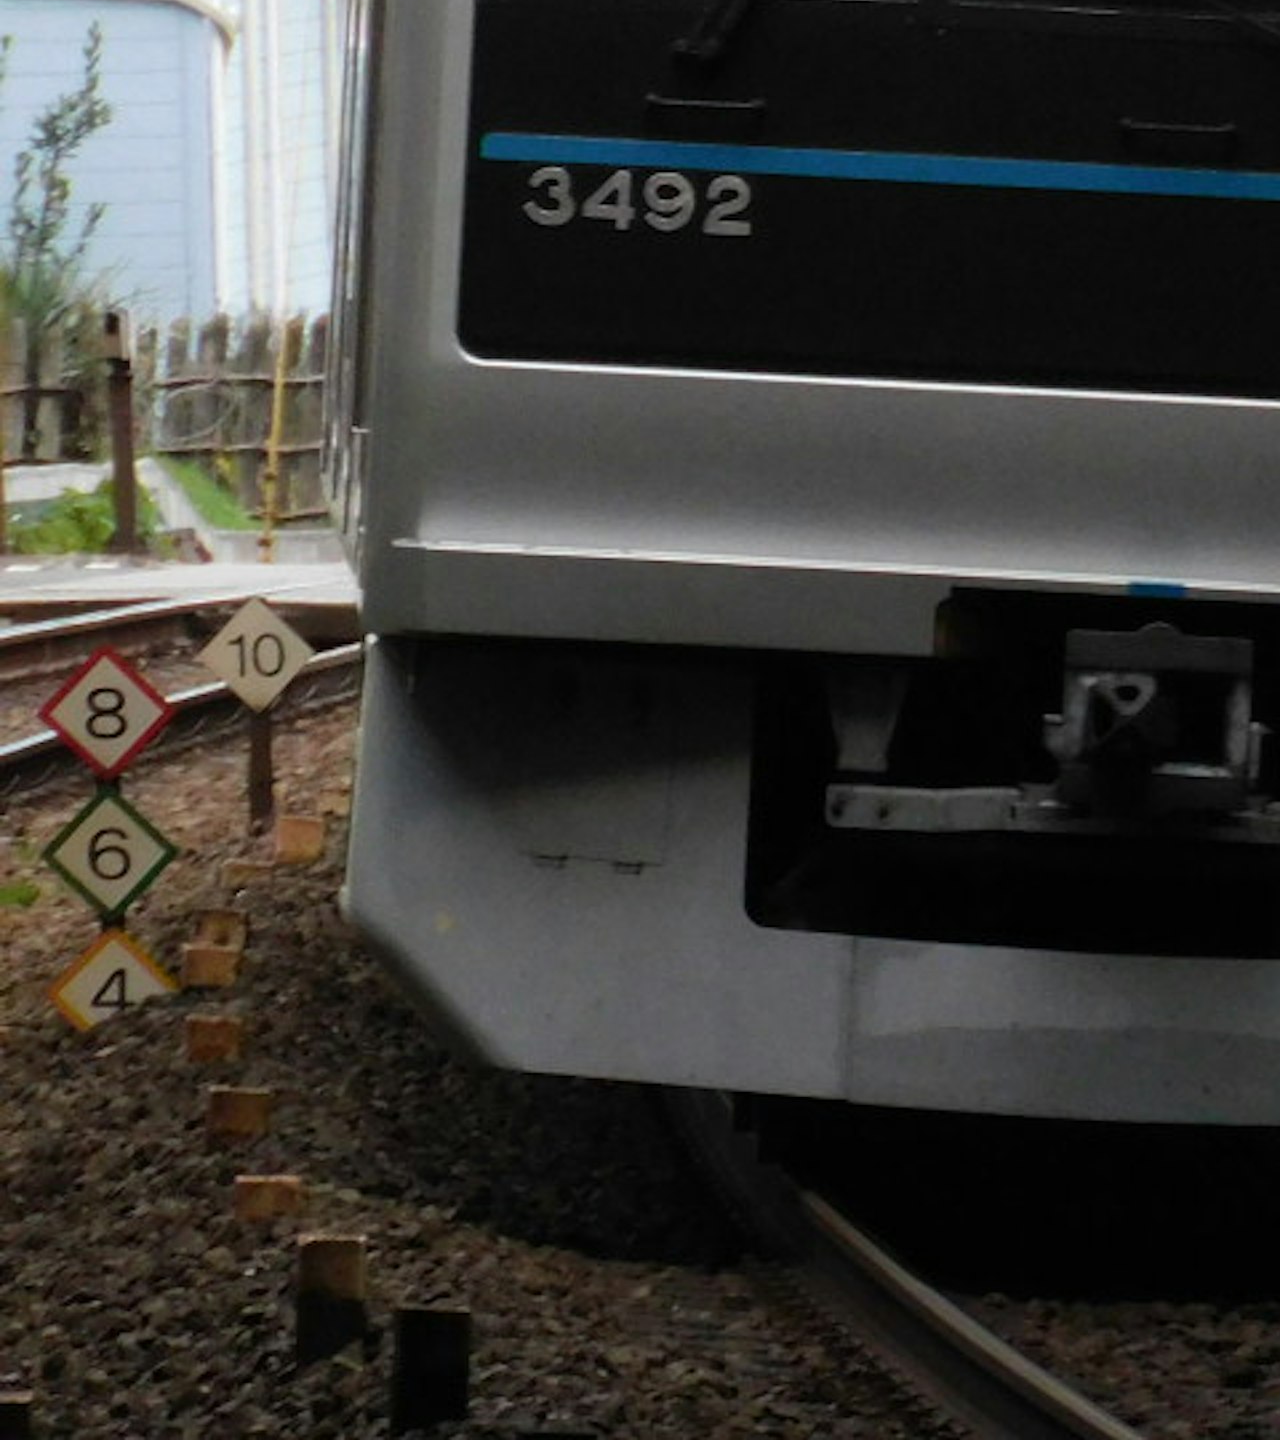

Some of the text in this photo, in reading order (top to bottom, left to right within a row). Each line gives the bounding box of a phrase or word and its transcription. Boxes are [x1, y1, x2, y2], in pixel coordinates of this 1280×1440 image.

[522, 165, 751, 236] 3492
[227, 633, 286, 678] 10
[84, 687, 129, 740] 8
[86, 828, 132, 881] 6
[90, 968, 134, 1009] 4
